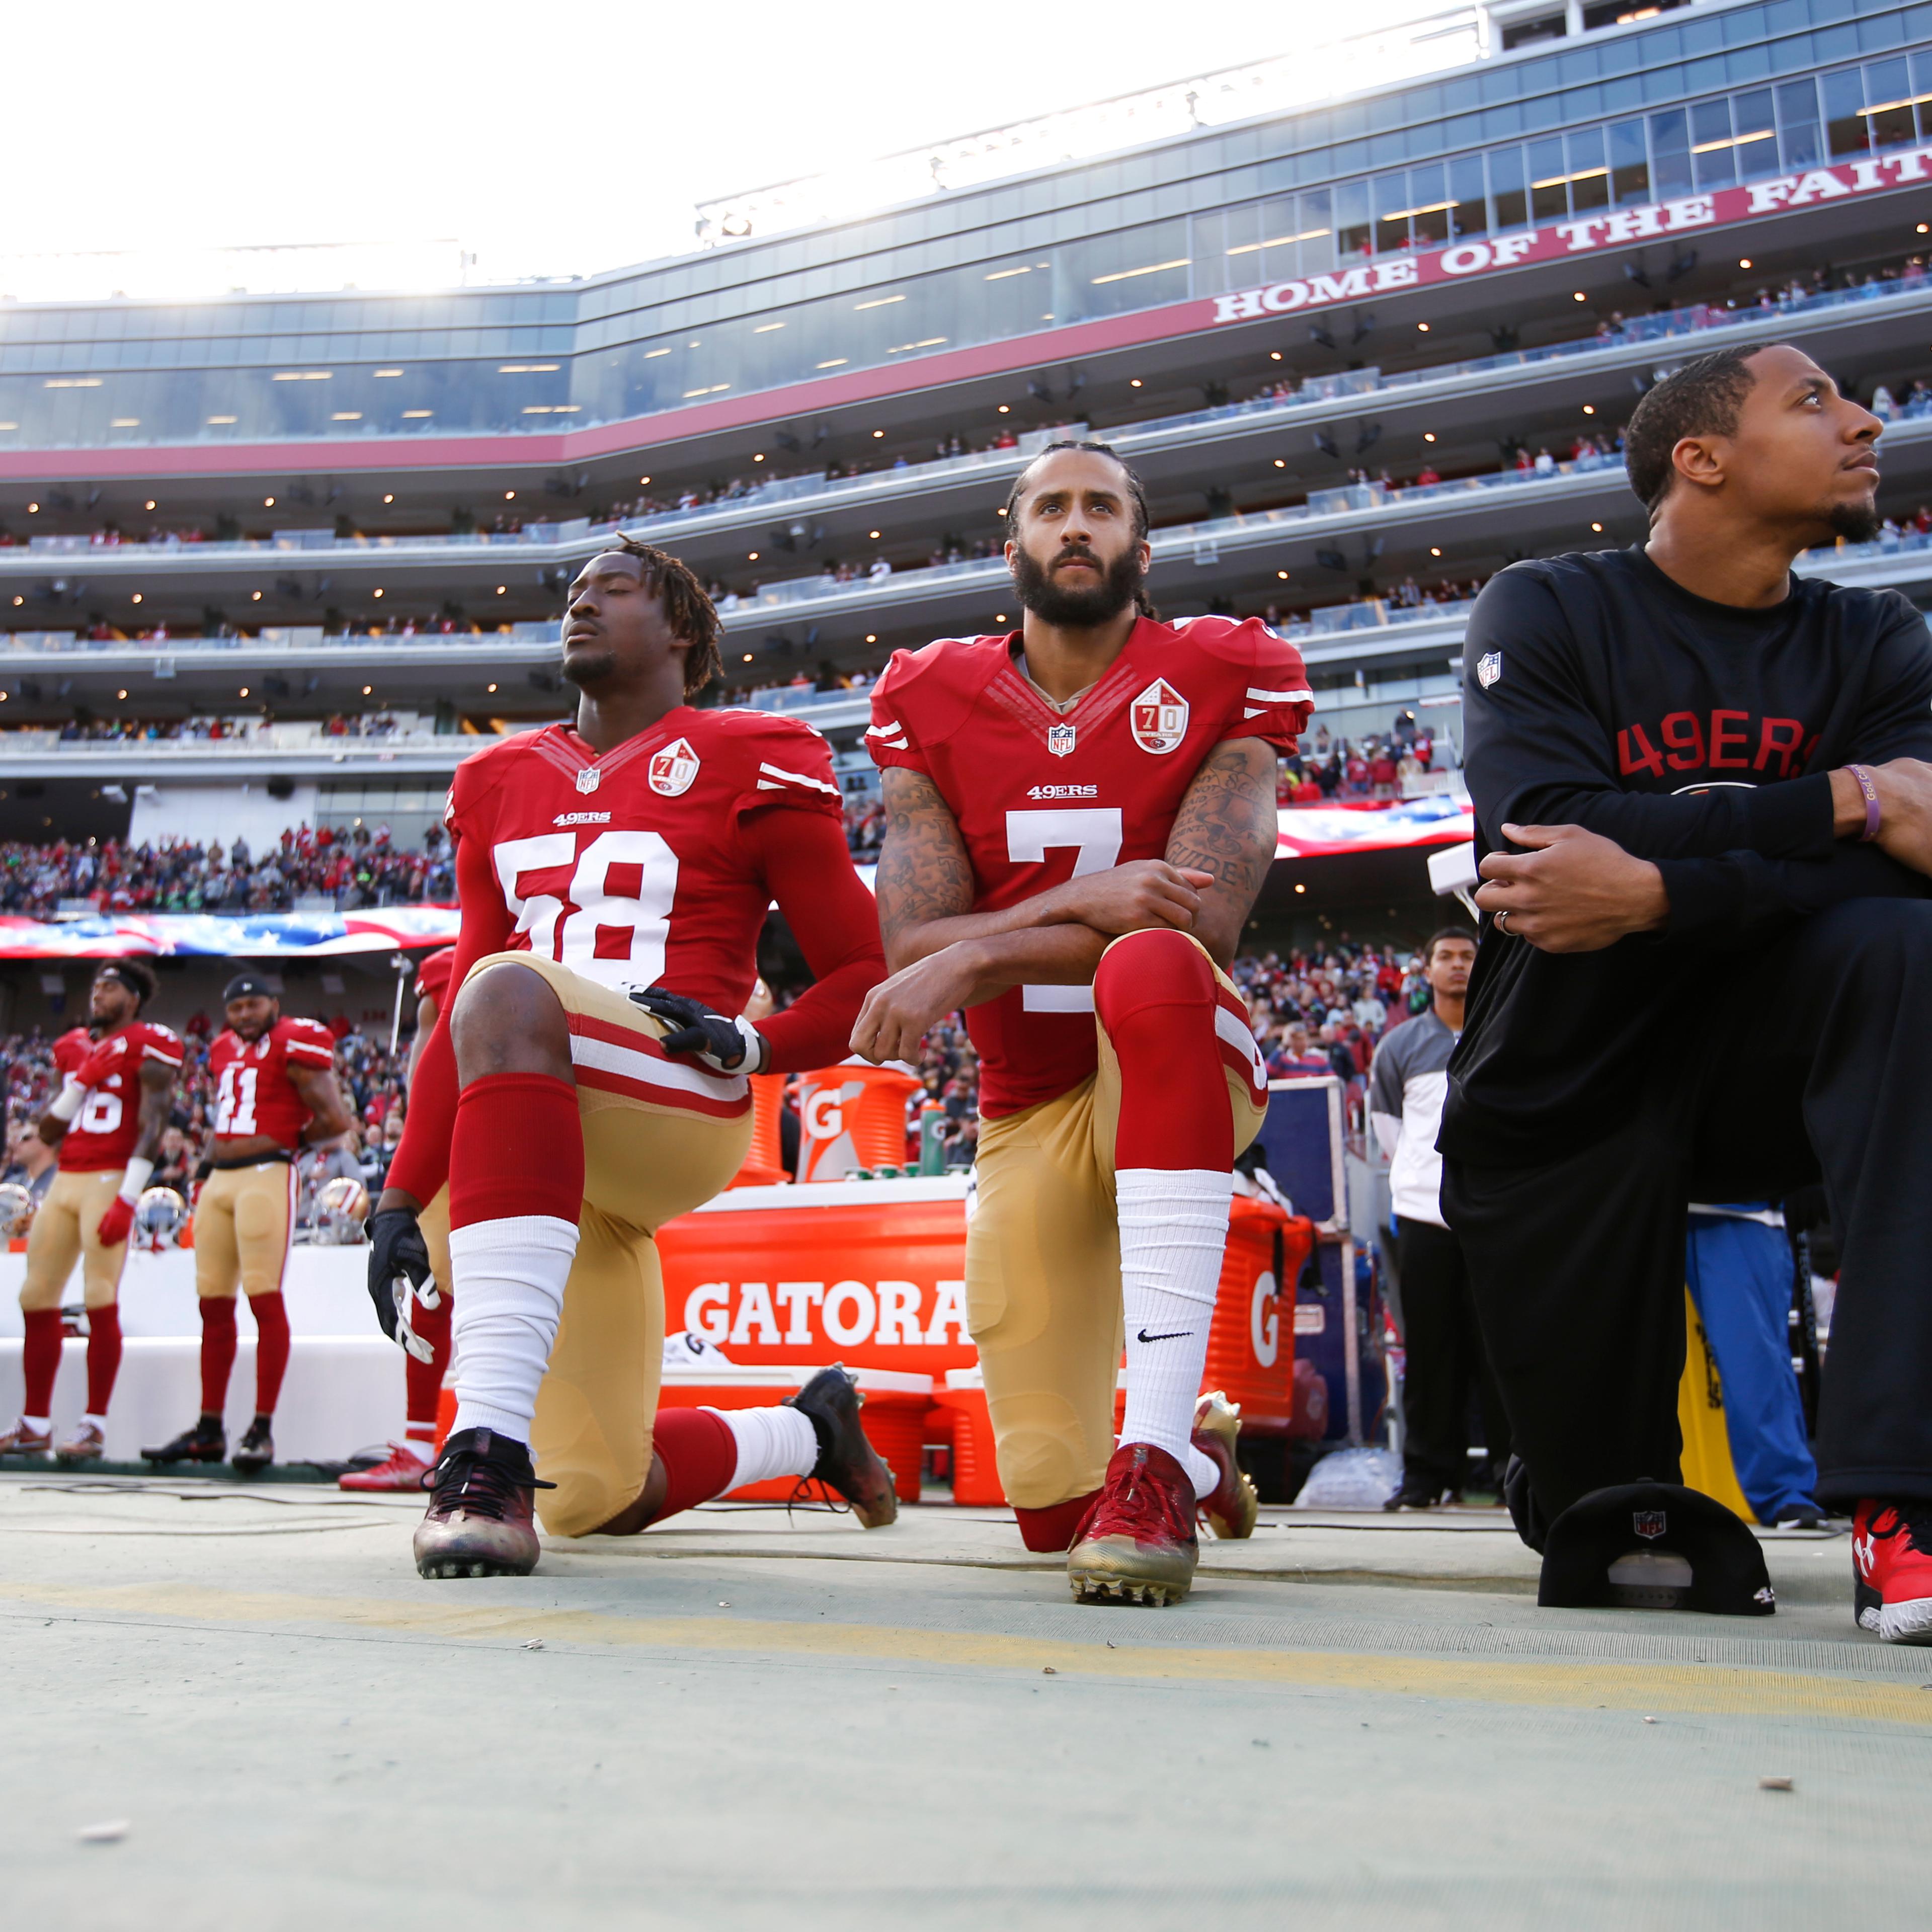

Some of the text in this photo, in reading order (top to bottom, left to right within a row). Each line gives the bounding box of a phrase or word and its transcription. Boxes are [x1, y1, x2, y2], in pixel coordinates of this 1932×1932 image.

[1214, 150, 1932, 325] HOME OF THE FAIT
[1053, 740, 1072, 752] NFL
[579, 778, 596, 790] NFL
[1027, 785, 1097, 800] 49ERS
[1865, 782, 1876, 800] God
[553, 811, 611, 826] 49ERS
[494, 831, 679, 994] 58
[806, 1089, 842, 1139] G
[684, 1280, 978, 1346] GATORA
[1251, 1271, 1278, 1367] G
